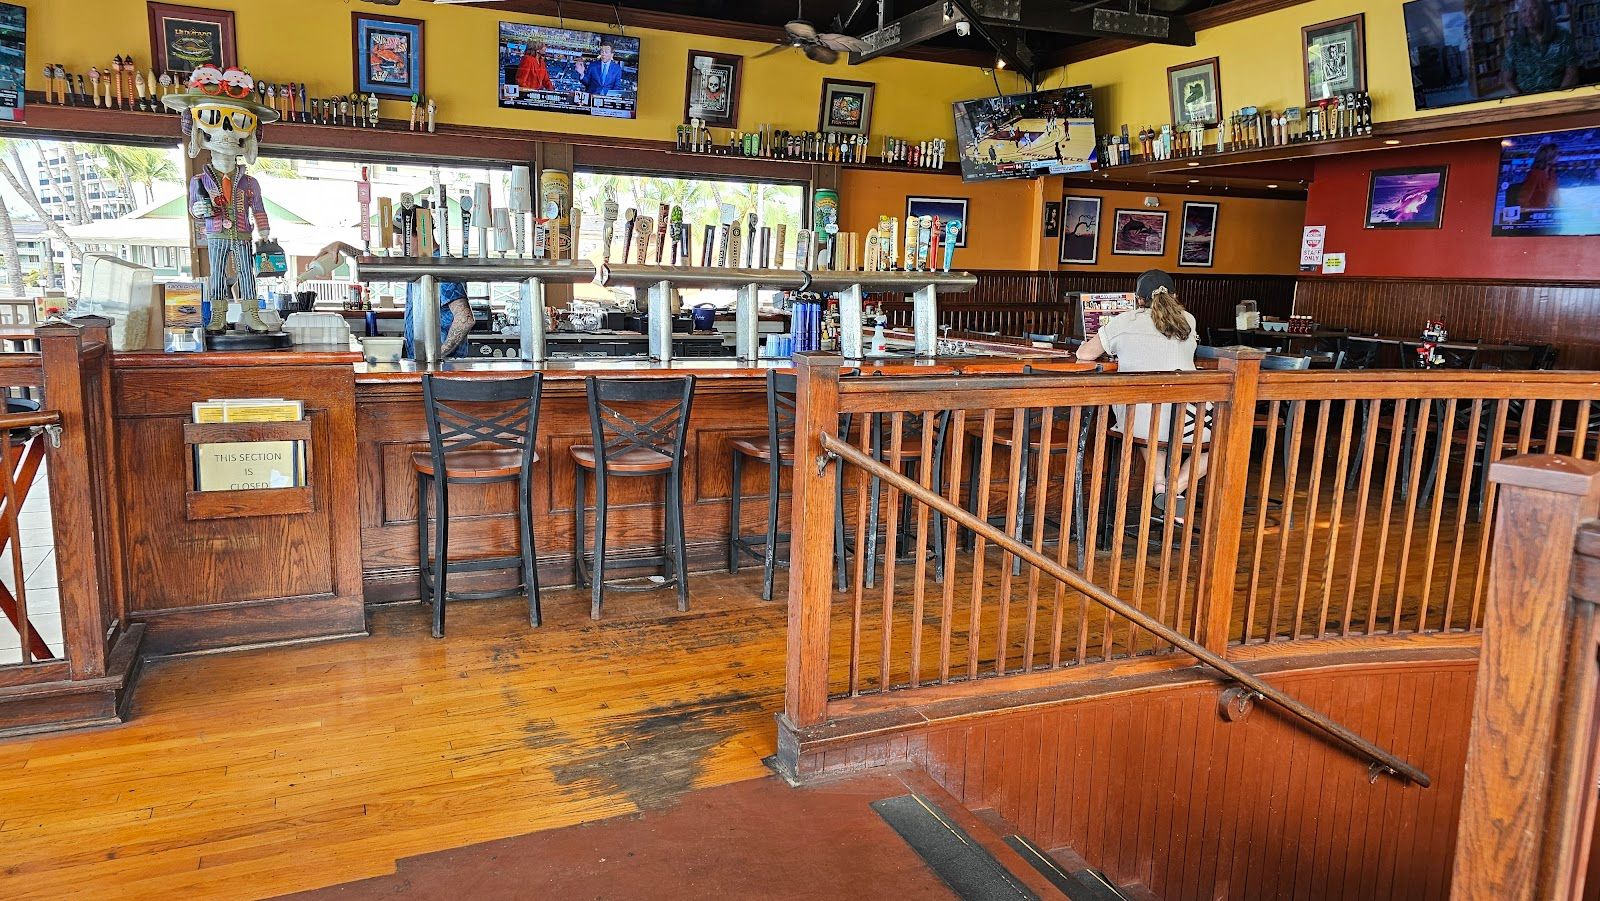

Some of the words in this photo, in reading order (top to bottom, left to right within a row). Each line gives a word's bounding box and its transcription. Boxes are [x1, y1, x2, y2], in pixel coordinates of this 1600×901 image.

[214, 454, 237, 462] THIS
[239, 453, 282, 462] SECTION
[245, 468, 254, 476] IS
[230, 482, 269, 490] CLOSED
